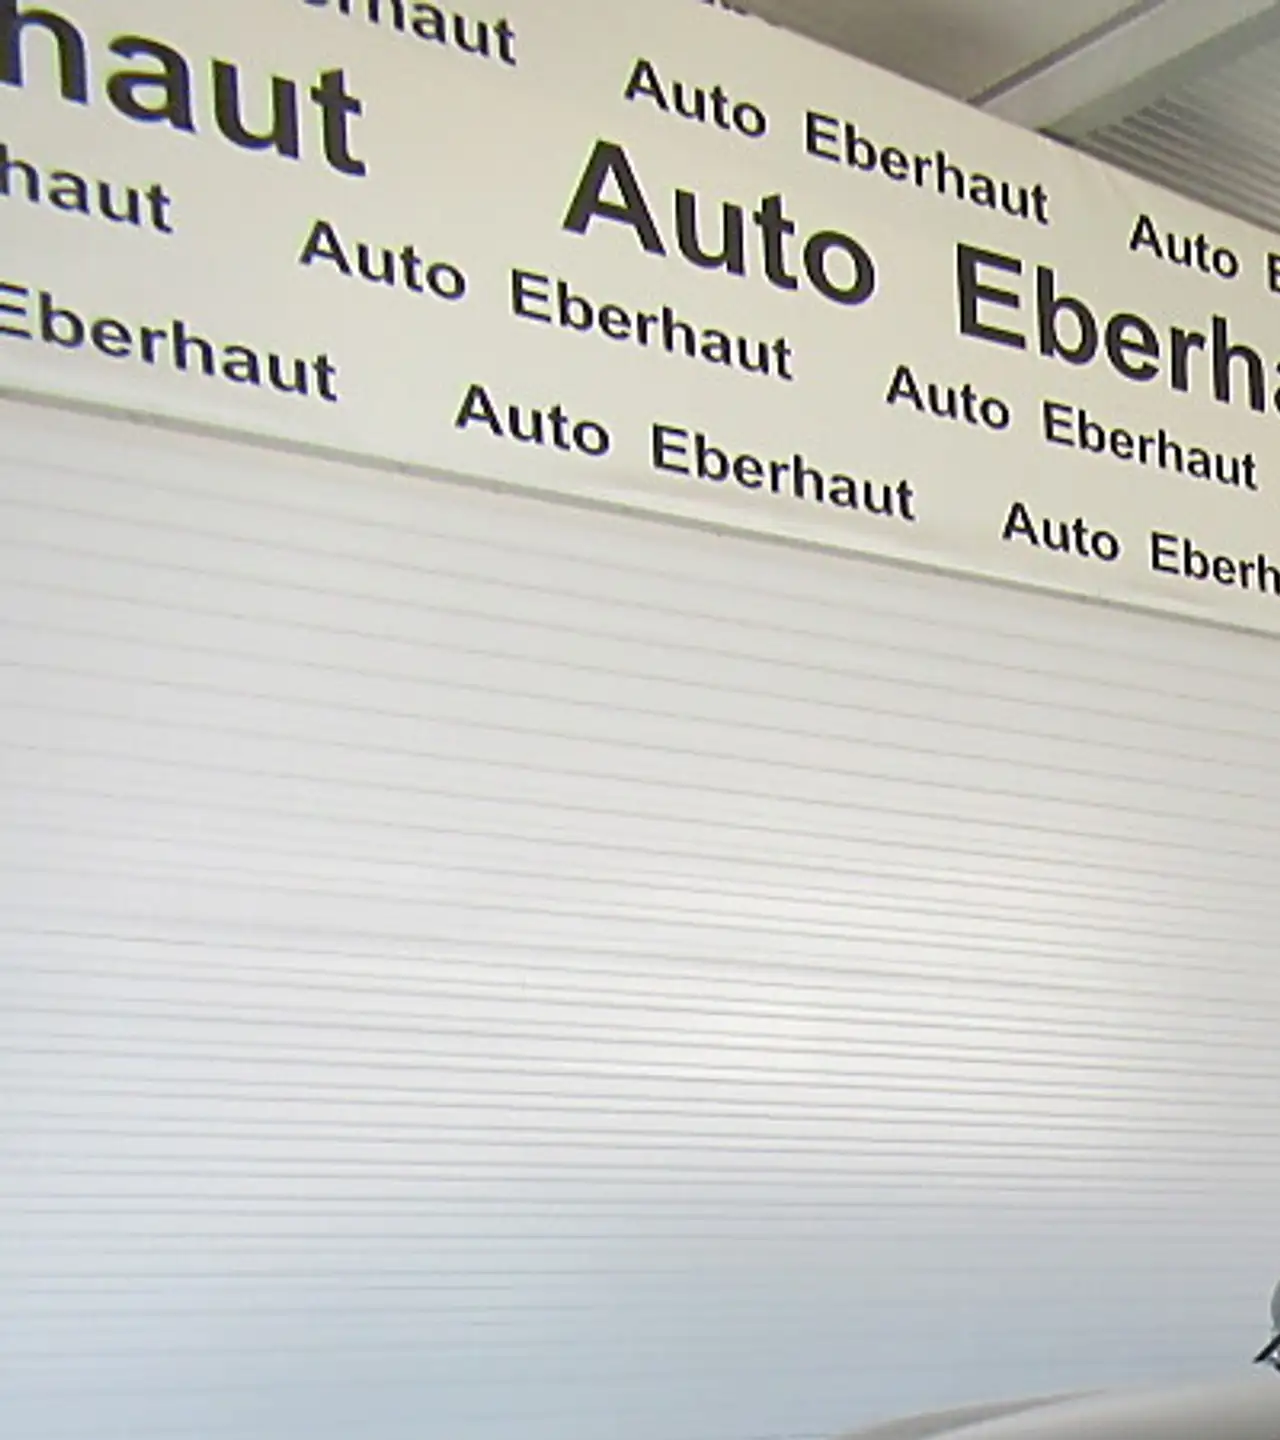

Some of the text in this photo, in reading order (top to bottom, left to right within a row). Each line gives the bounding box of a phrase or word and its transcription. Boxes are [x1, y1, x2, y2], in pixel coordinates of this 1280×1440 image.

[625, 60, 1048, 225] Auto Eberhaut
[563, 140, 877, 306] Auto
[1130, 214, 1238, 278] Auto
[0, 282, 337, 401] Eberhaut
[300, 221, 792, 380] Auto Eberhaut
[456, 384, 914, 520] Auto Eberhaut
[887, 365, 1258, 490] Auto Eberhaut
[1003, 502, 1119, 561] Auto
